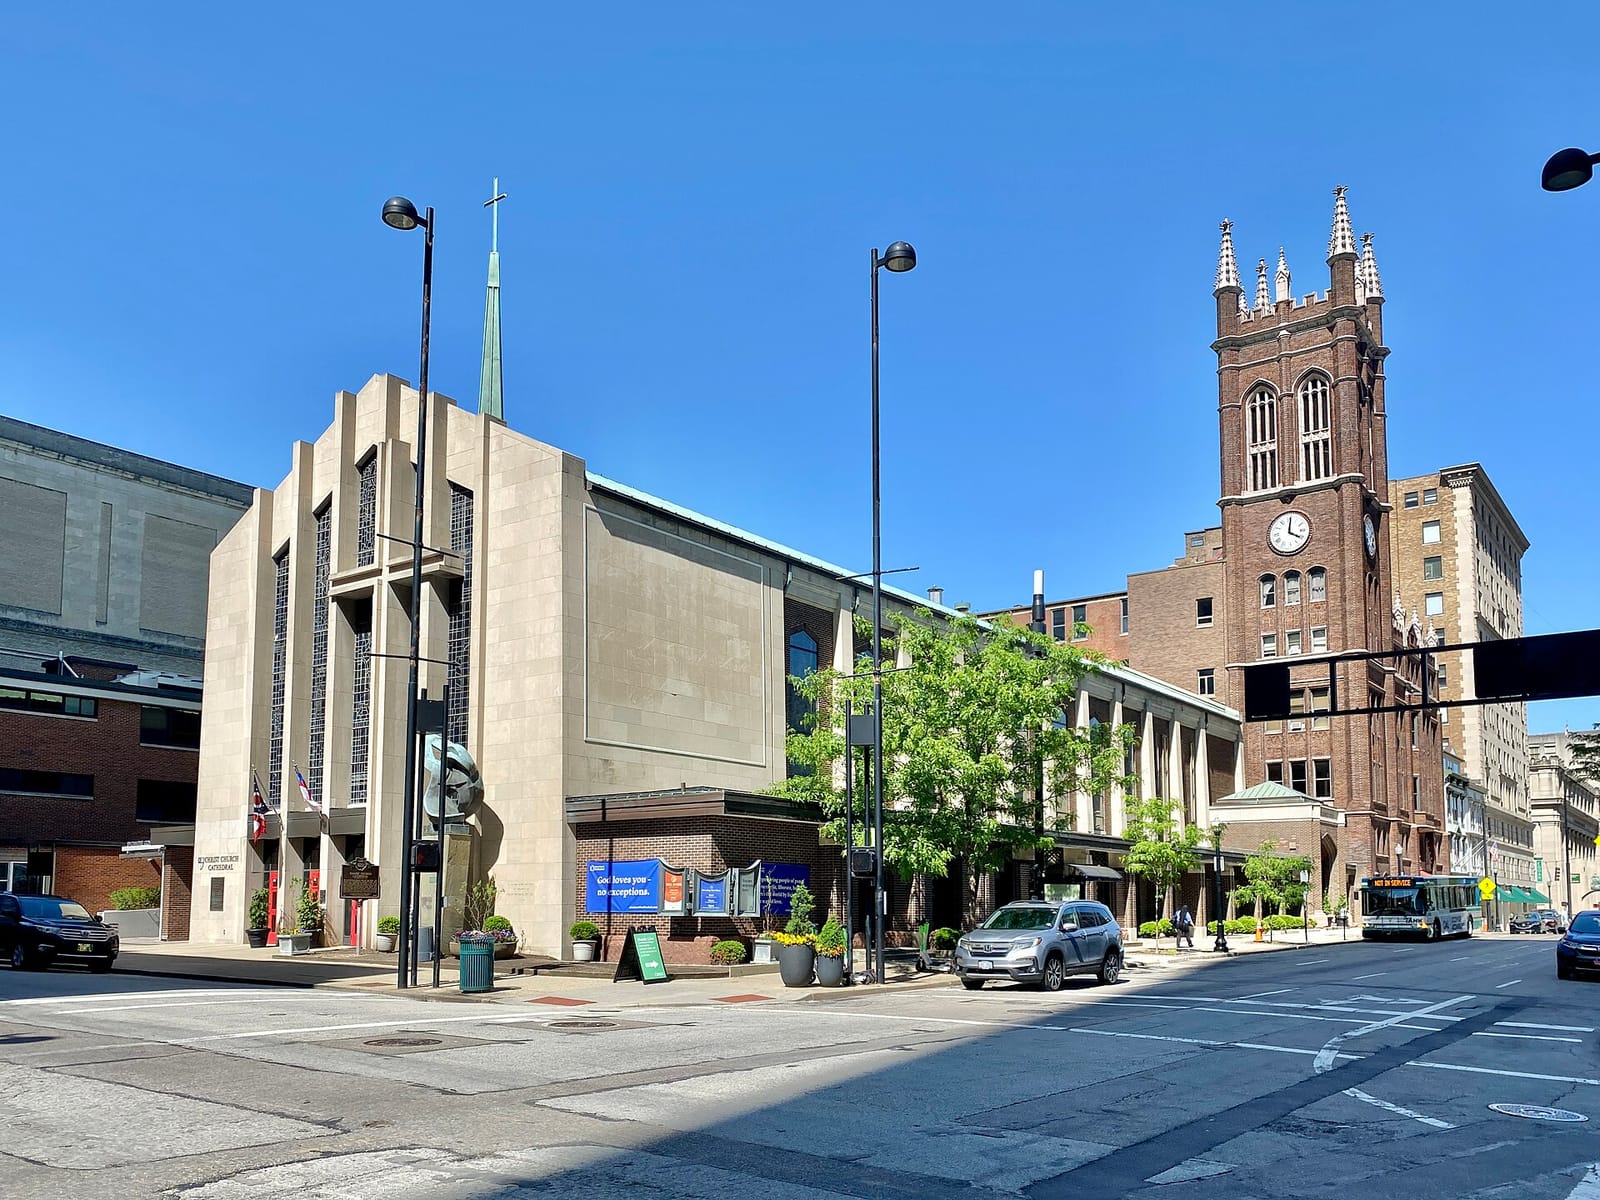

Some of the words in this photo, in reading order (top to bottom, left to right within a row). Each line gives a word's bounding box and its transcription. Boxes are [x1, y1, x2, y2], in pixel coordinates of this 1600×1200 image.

[597, 876, 611, 884] God
[612, 876, 631, 884] loves
[632, 877, 646, 885] you
[608, 887, 650, 898] exceptions.
